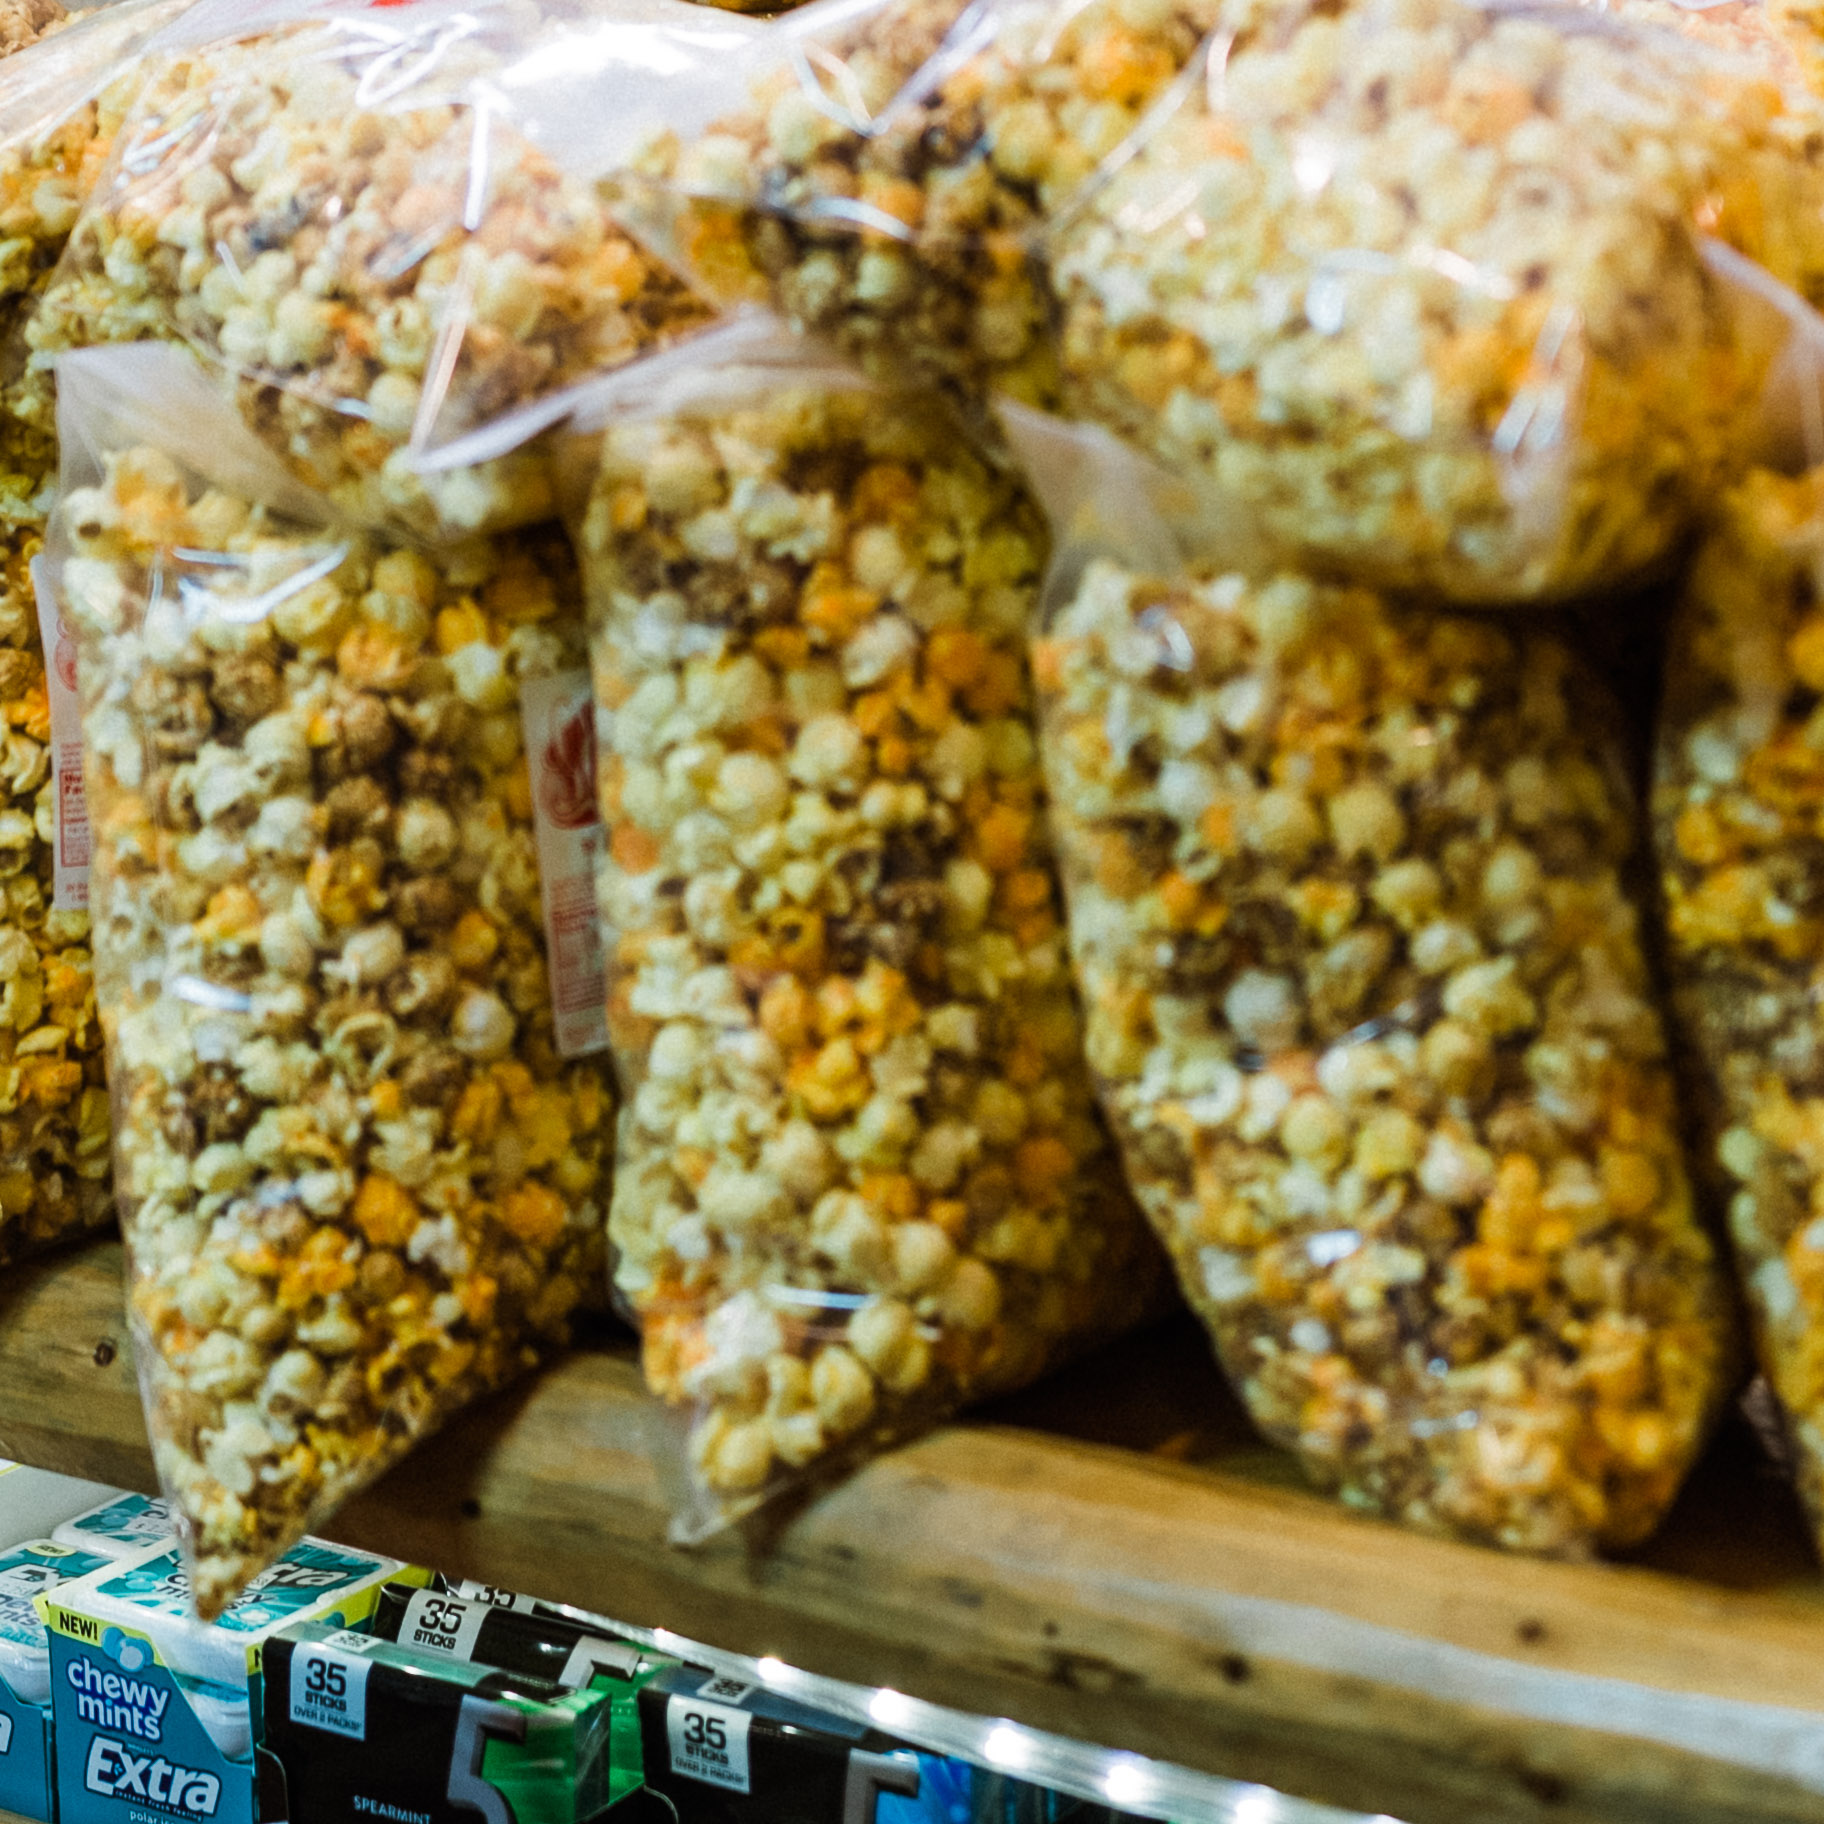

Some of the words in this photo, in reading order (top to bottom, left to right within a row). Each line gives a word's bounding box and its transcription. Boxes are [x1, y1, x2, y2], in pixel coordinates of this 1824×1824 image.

[59, 1610, 99, 1641] NEW!
[419, 1598, 468, 1635] 35
[413, 1628, 457, 1651] STICKS
[67, 1656, 169, 1718] chewy
[305, 1657, 348, 1697] 35
[77, 1692, 161, 1740] mints
[304, 1690, 348, 1713] STICKS
[683, 1712, 727, 1751] 35
[685, 1743, 729, 1765] STICKS
[85, 1734, 221, 1816] Extra
[129, 1809, 159, 1824] polar
[352, 1794, 432, 1824] SPEARMINT
